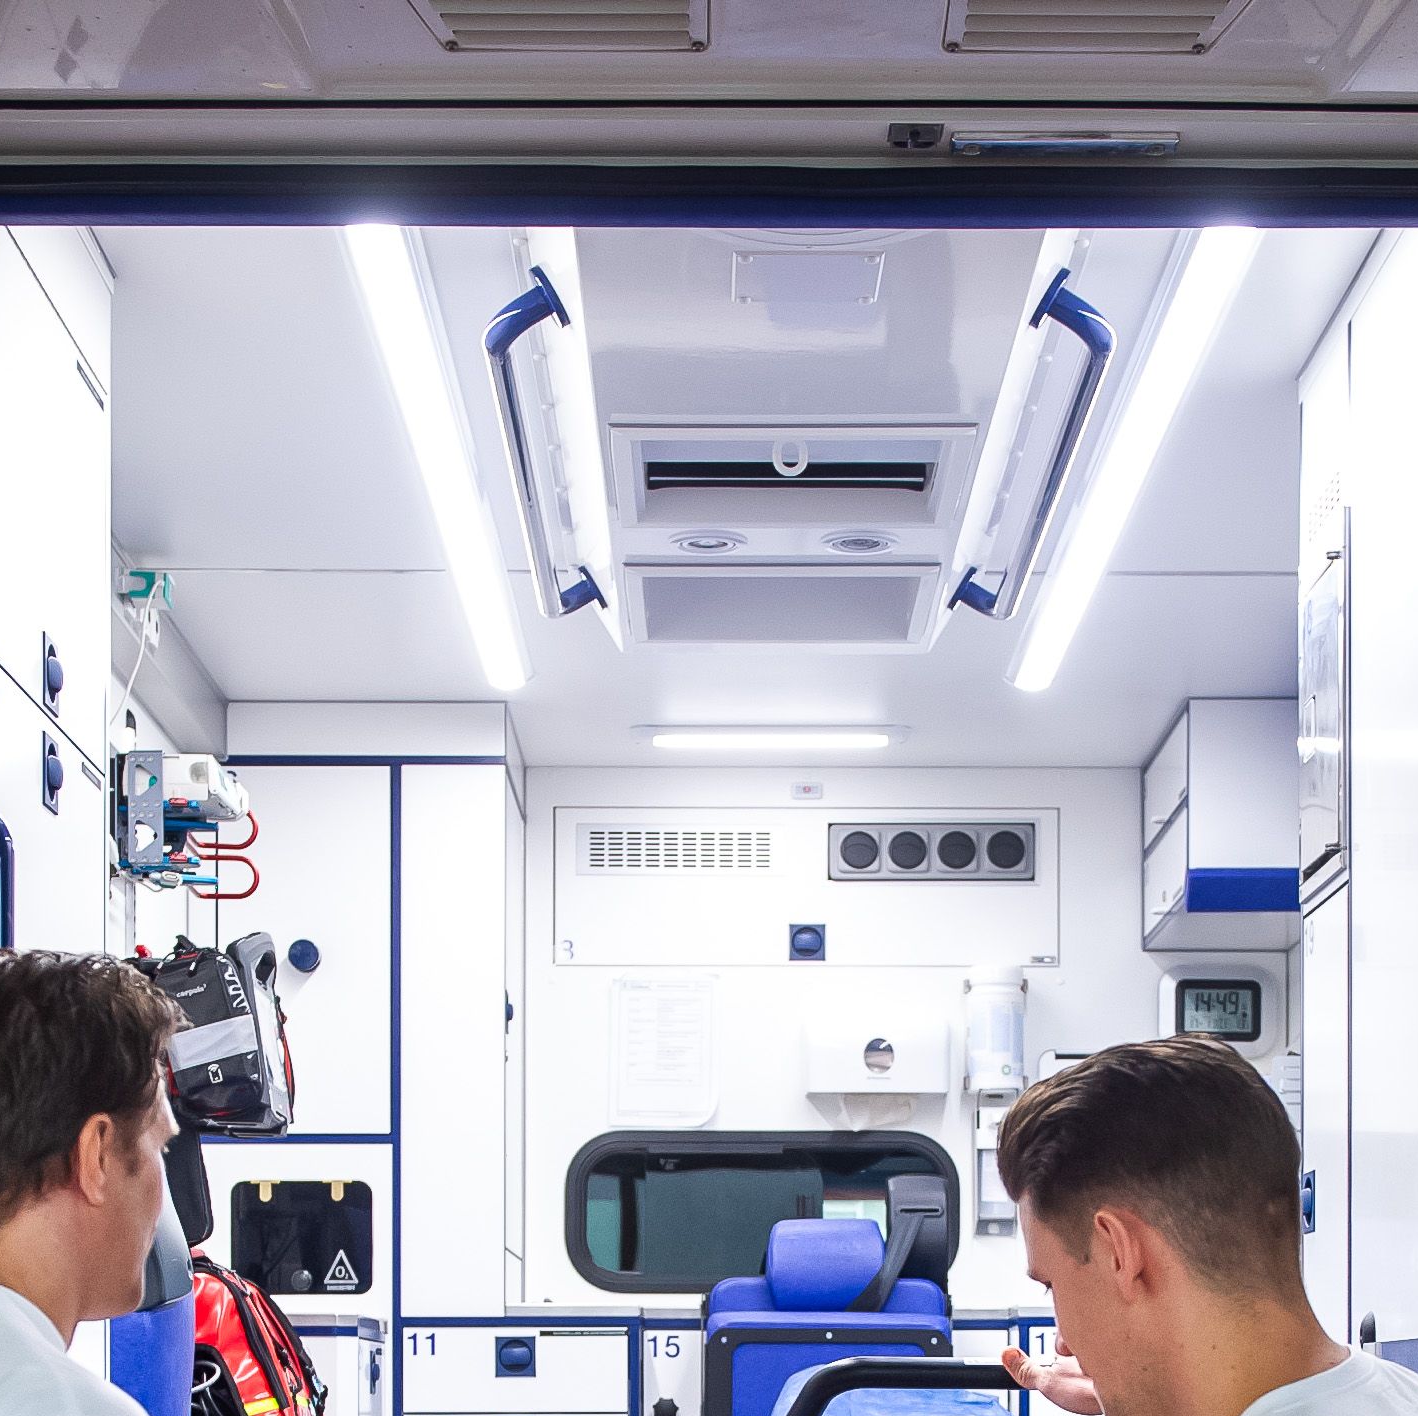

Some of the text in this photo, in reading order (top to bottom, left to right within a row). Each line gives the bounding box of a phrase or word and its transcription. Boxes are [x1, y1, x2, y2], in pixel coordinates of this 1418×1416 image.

[561, 939, 575, 960] 3
[407, 1332, 437, 1356] 11
[647, 1335, 681, 1358] 15
